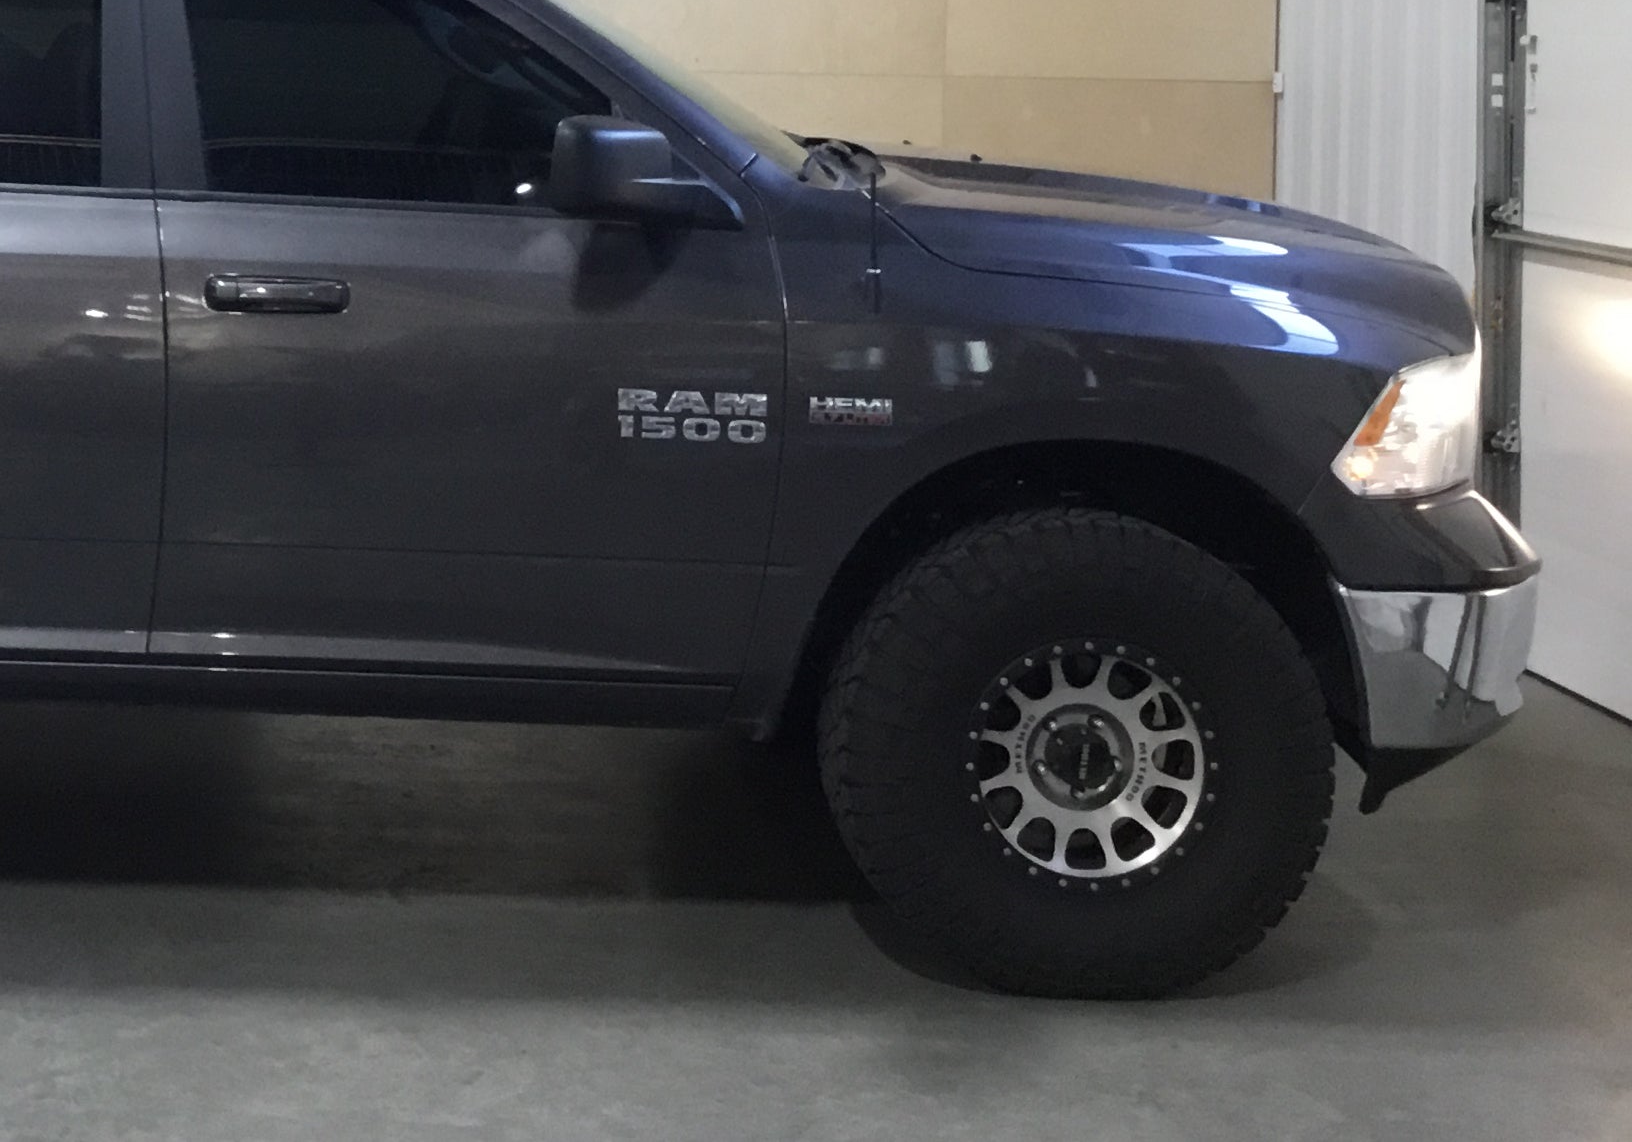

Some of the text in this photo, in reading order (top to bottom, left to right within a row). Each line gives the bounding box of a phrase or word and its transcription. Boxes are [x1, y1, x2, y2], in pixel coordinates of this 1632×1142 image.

[618, 388, 767, 416] RAM
[809, 397, 892, 414] HEMI
[618, 415, 766, 444] 1500
